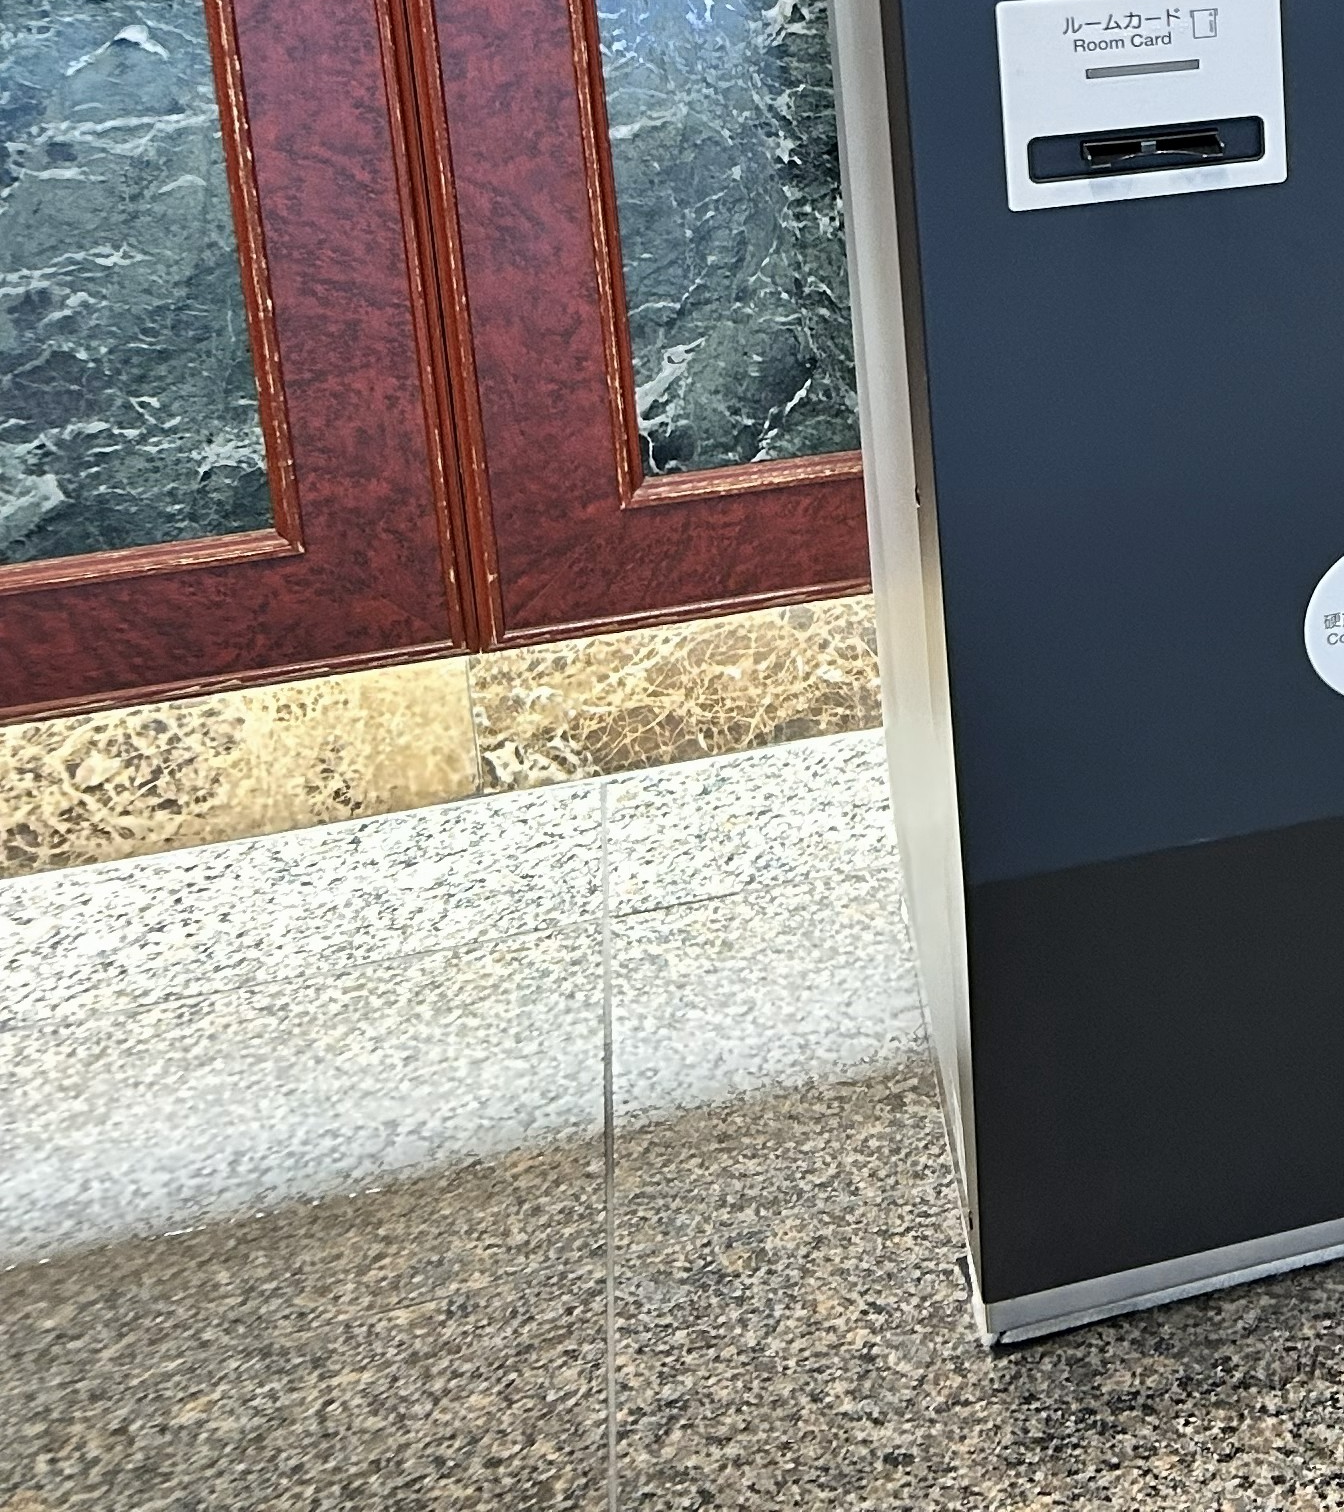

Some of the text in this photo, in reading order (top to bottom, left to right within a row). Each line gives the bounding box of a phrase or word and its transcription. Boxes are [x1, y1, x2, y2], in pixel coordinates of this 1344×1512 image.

[1062, 7, 1181, 36] ルームカード
[1073, 31, 1172, 53] Room Card
